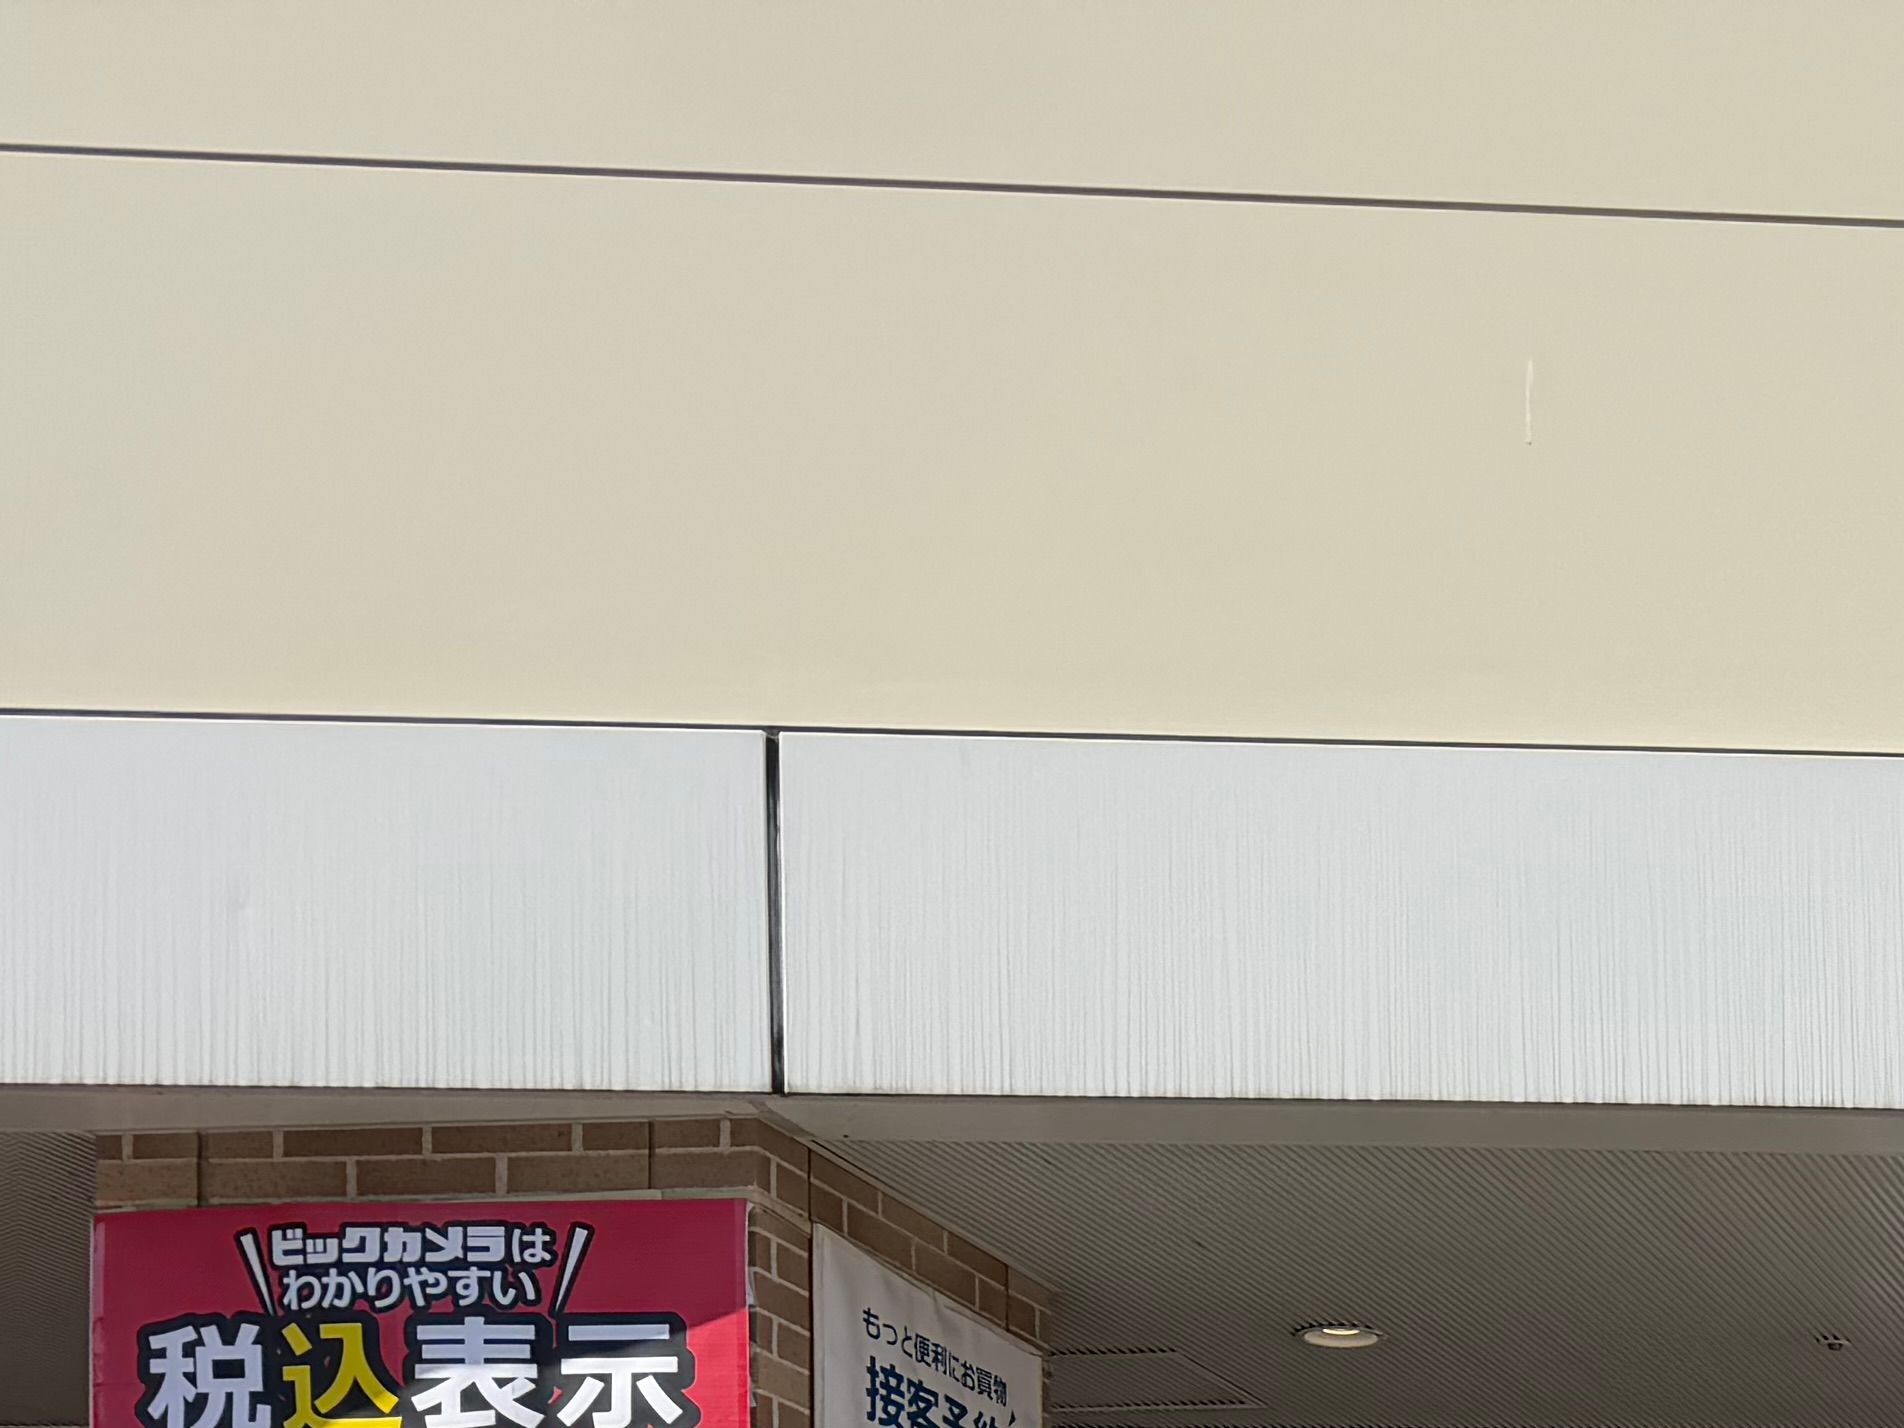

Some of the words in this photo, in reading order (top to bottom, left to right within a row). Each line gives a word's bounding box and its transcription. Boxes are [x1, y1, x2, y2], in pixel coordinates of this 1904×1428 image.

[274, 1226, 552, 1268] ビックカメラは
[284, 1266, 537, 1309] わかりやすい
[863, 1307, 1006, 1407] もっと便利にお買物
